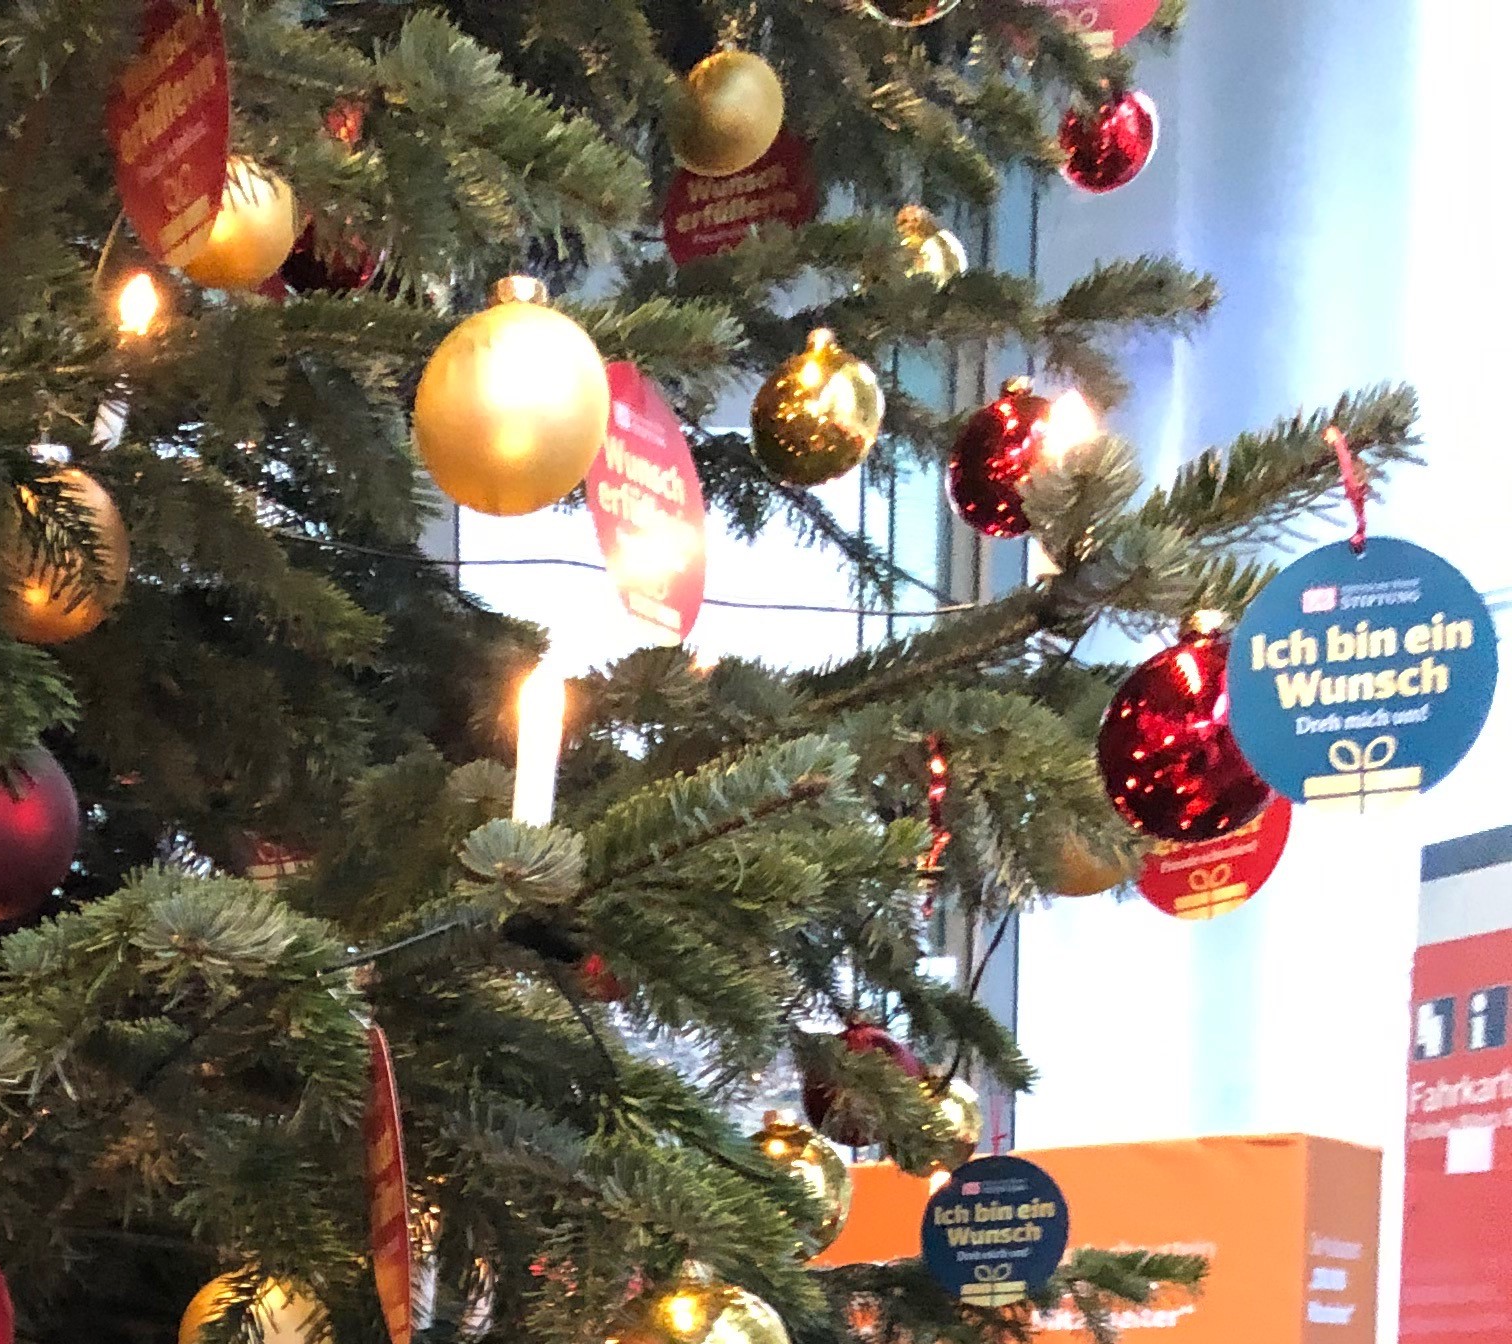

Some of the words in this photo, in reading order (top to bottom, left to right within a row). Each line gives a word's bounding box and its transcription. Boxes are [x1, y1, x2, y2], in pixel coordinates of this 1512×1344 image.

[1251, 629, 1318, 671] Ich
[1326, 620, 1398, 663] bin
[1404, 612, 1475, 655] ein
[1275, 656, 1450, 710] Wunsch
[934, 1205, 970, 1226] Ich
[974, 1201, 1014, 1222] bin
[1017, 1198, 1056, 1219] ein
[947, 1221, 1043, 1247] Wunsch
